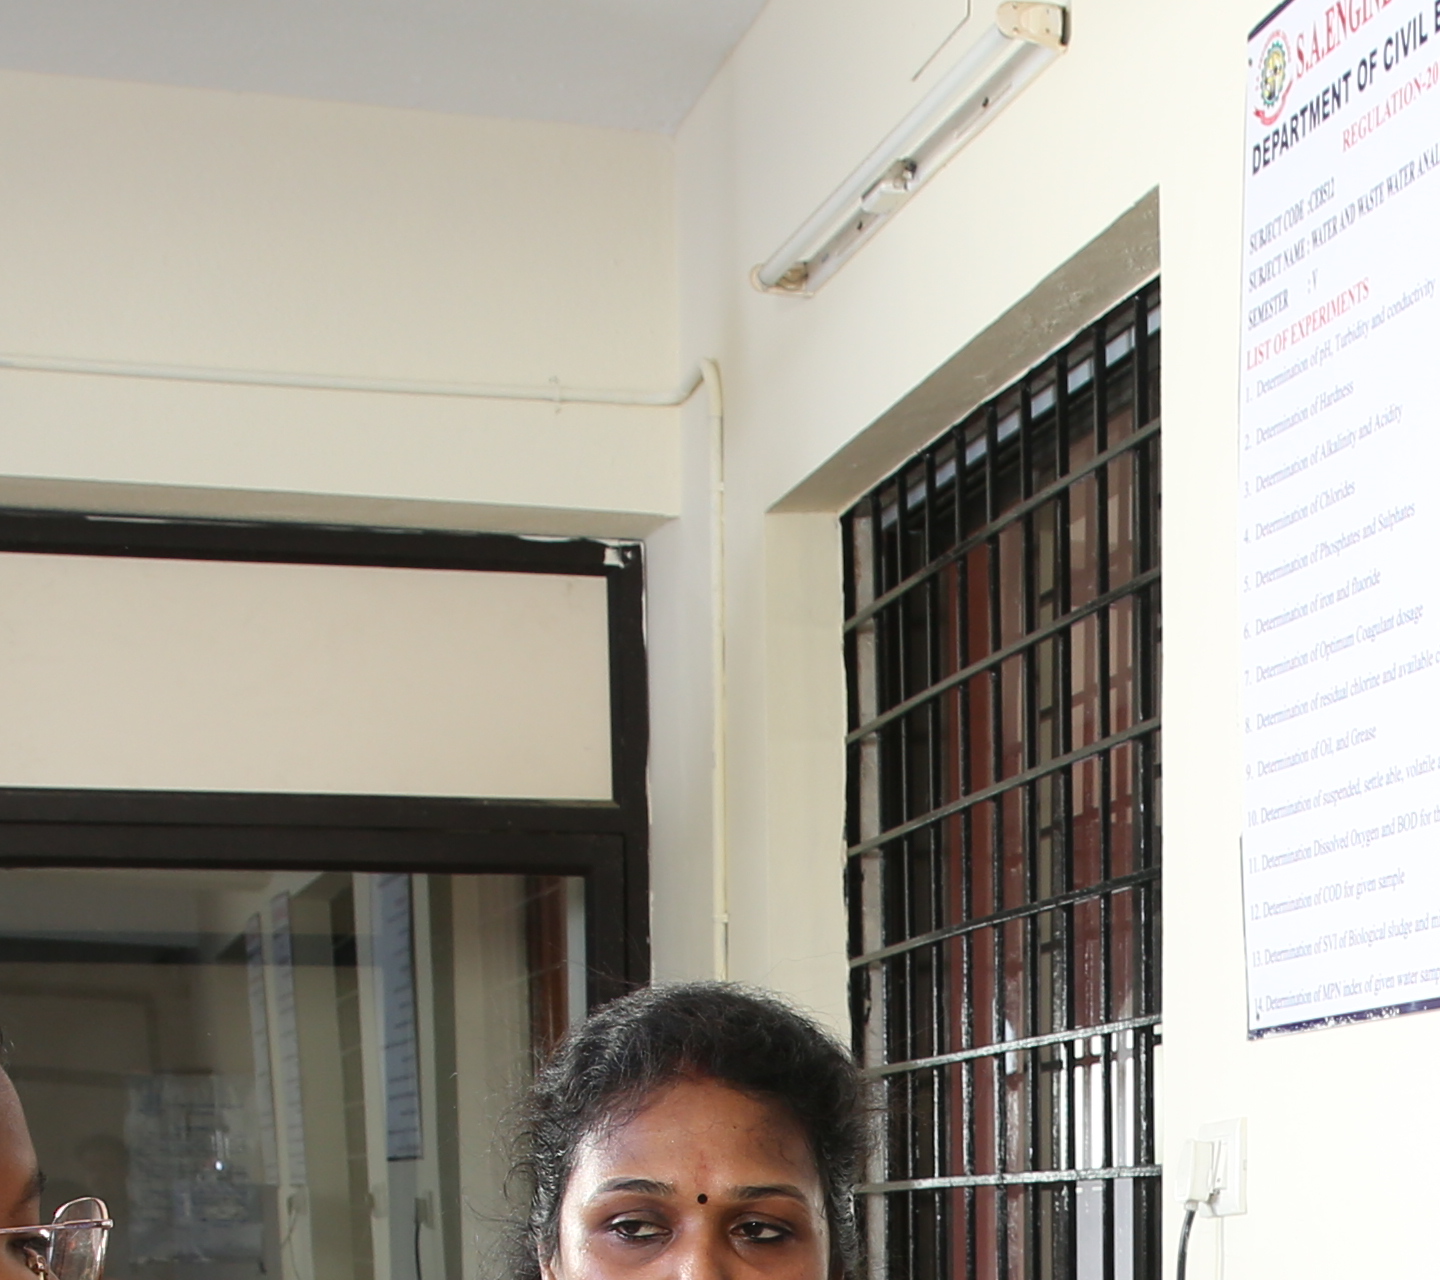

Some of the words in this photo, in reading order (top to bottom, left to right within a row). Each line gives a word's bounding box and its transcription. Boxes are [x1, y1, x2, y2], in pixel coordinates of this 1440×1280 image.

[1252, 70, 1350, 176] DEPARTMENT
[1357, 48, 1377, 96] OF
[1383, 9, 1427, 74] CIVIL
[1249, 252, 1281, 294] SUBJECT
[1283, 236, 1305, 270] NAME
[1312, 213, 1337, 250] WATER
[1340, 201, 1355, 231] AND
[1357, 180, 1384, 219] WASTE
[1387, 159, 1414, 199] WATER
[1249, 213, 1281, 256] SUBJECT
[1284, 198, 1303, 232] CODE
[1246, 337, 1270, 372] LIST
[1273, 326, 1289, 356] OF
[1291, 275, 1369, 346] EXPERIMENTS
[1248, 285, 1288, 333] SEMESTER
[1257, 351, 1307, 400] Determination
[1310, 346, 1318, 368] of
[1335, 316, 1368, 356] Turbidity
[1371, 306, 1384, 331] and
[1386, 273, 1435, 324] conductivity
[1256, 400, 1307, 447] Determination
[1309, 395, 1318, 416] of
[1319, 376, 1353, 411] Hardness
[1256, 449, 1307, 495] Determination
[1310, 445, 1319, 466] of
[1320, 425, 1355, 465] Alkalinity
[1358, 416, 1371, 440] and
[1374, 399, 1402, 435] Acidity
[1255, 498, 1307, 542] Determination
[1310, 494, 1319, 514] of
[1319, 475, 1355, 511] Chlorides
[1255, 547, 1308, 590] Determination
[1310, 544, 1319, 565] of
[1320, 524, 1360, 564] Phosphates
[1362, 517, 1375, 540] and
[1378, 498, 1415, 536] Sulphates
[1255, 597, 1308, 637] Determination
[1310, 593, 1318, 613] of
[1319, 587, 1333, 609] iron
[1336, 580, 1349, 602] and
[1351, 565, 1380, 596] fluoride
[1256, 646, 1308, 684] Determination
[1310, 643, 1319, 663] of
[1356, 612, 1394, 648] Coagulant
[1396, 600, 1422, 631] dosage
[1256, 695, 1308, 732] Determination
[1310, 692, 1319, 712] of
[1320, 681, 1348, 708] residual
[1350, 668, 1379, 697] chlorine
[1382, 662, 1395, 684] and
[1398, 647, 1432, 678] available
[1257, 743, 1308, 778] Determination
[1311, 741, 1319, 760] of
[1336, 731, 1348, 751] and
[1350, 721, 1376, 747] Grease
[1260, 792, 1310, 825] Determination
[1313, 790, 1321, 808] of
[1406, 752, 1434, 779] volatile
[1262, 841, 1311, 872] Determination
[1313, 830, 1348, 857] Dissolved
[1350, 822, 1378, 851] Oxygen
[1381, 817, 1394, 838] and
[1397, 811, 1416, 833] BOD
[1420, 806, 1432, 827] for
[1263, 889, 1311, 918] Determination
[1313, 887, 1321, 905] of
[1323, 882, 1341, 903] COD
[1344, 879, 1353, 898] for
[1356, 874, 1375, 899] given
[1378, 866, 1404, 894] sample
[1264, 938, 1311, 965] Determination
[1314, 936, 1321, 954] of
[1323, 933, 1337, 952] SVI
[1339, 931, 1346, 948] of
[1348, 922, 1385, 951] Biological
[1388, 916, 1412, 942] sludge
[1414, 912, 1428, 933] and
[1266, 987, 1311, 1011] Determination
[1314, 985, 1321, 1002] of
[1322, 981, 1341, 1000] MPN
[1343, 976, 1362, 996] index
[1364, 974, 1373, 993] of
[1374, 970, 1394, 995] given
[1397, 967, 1417, 986] water
